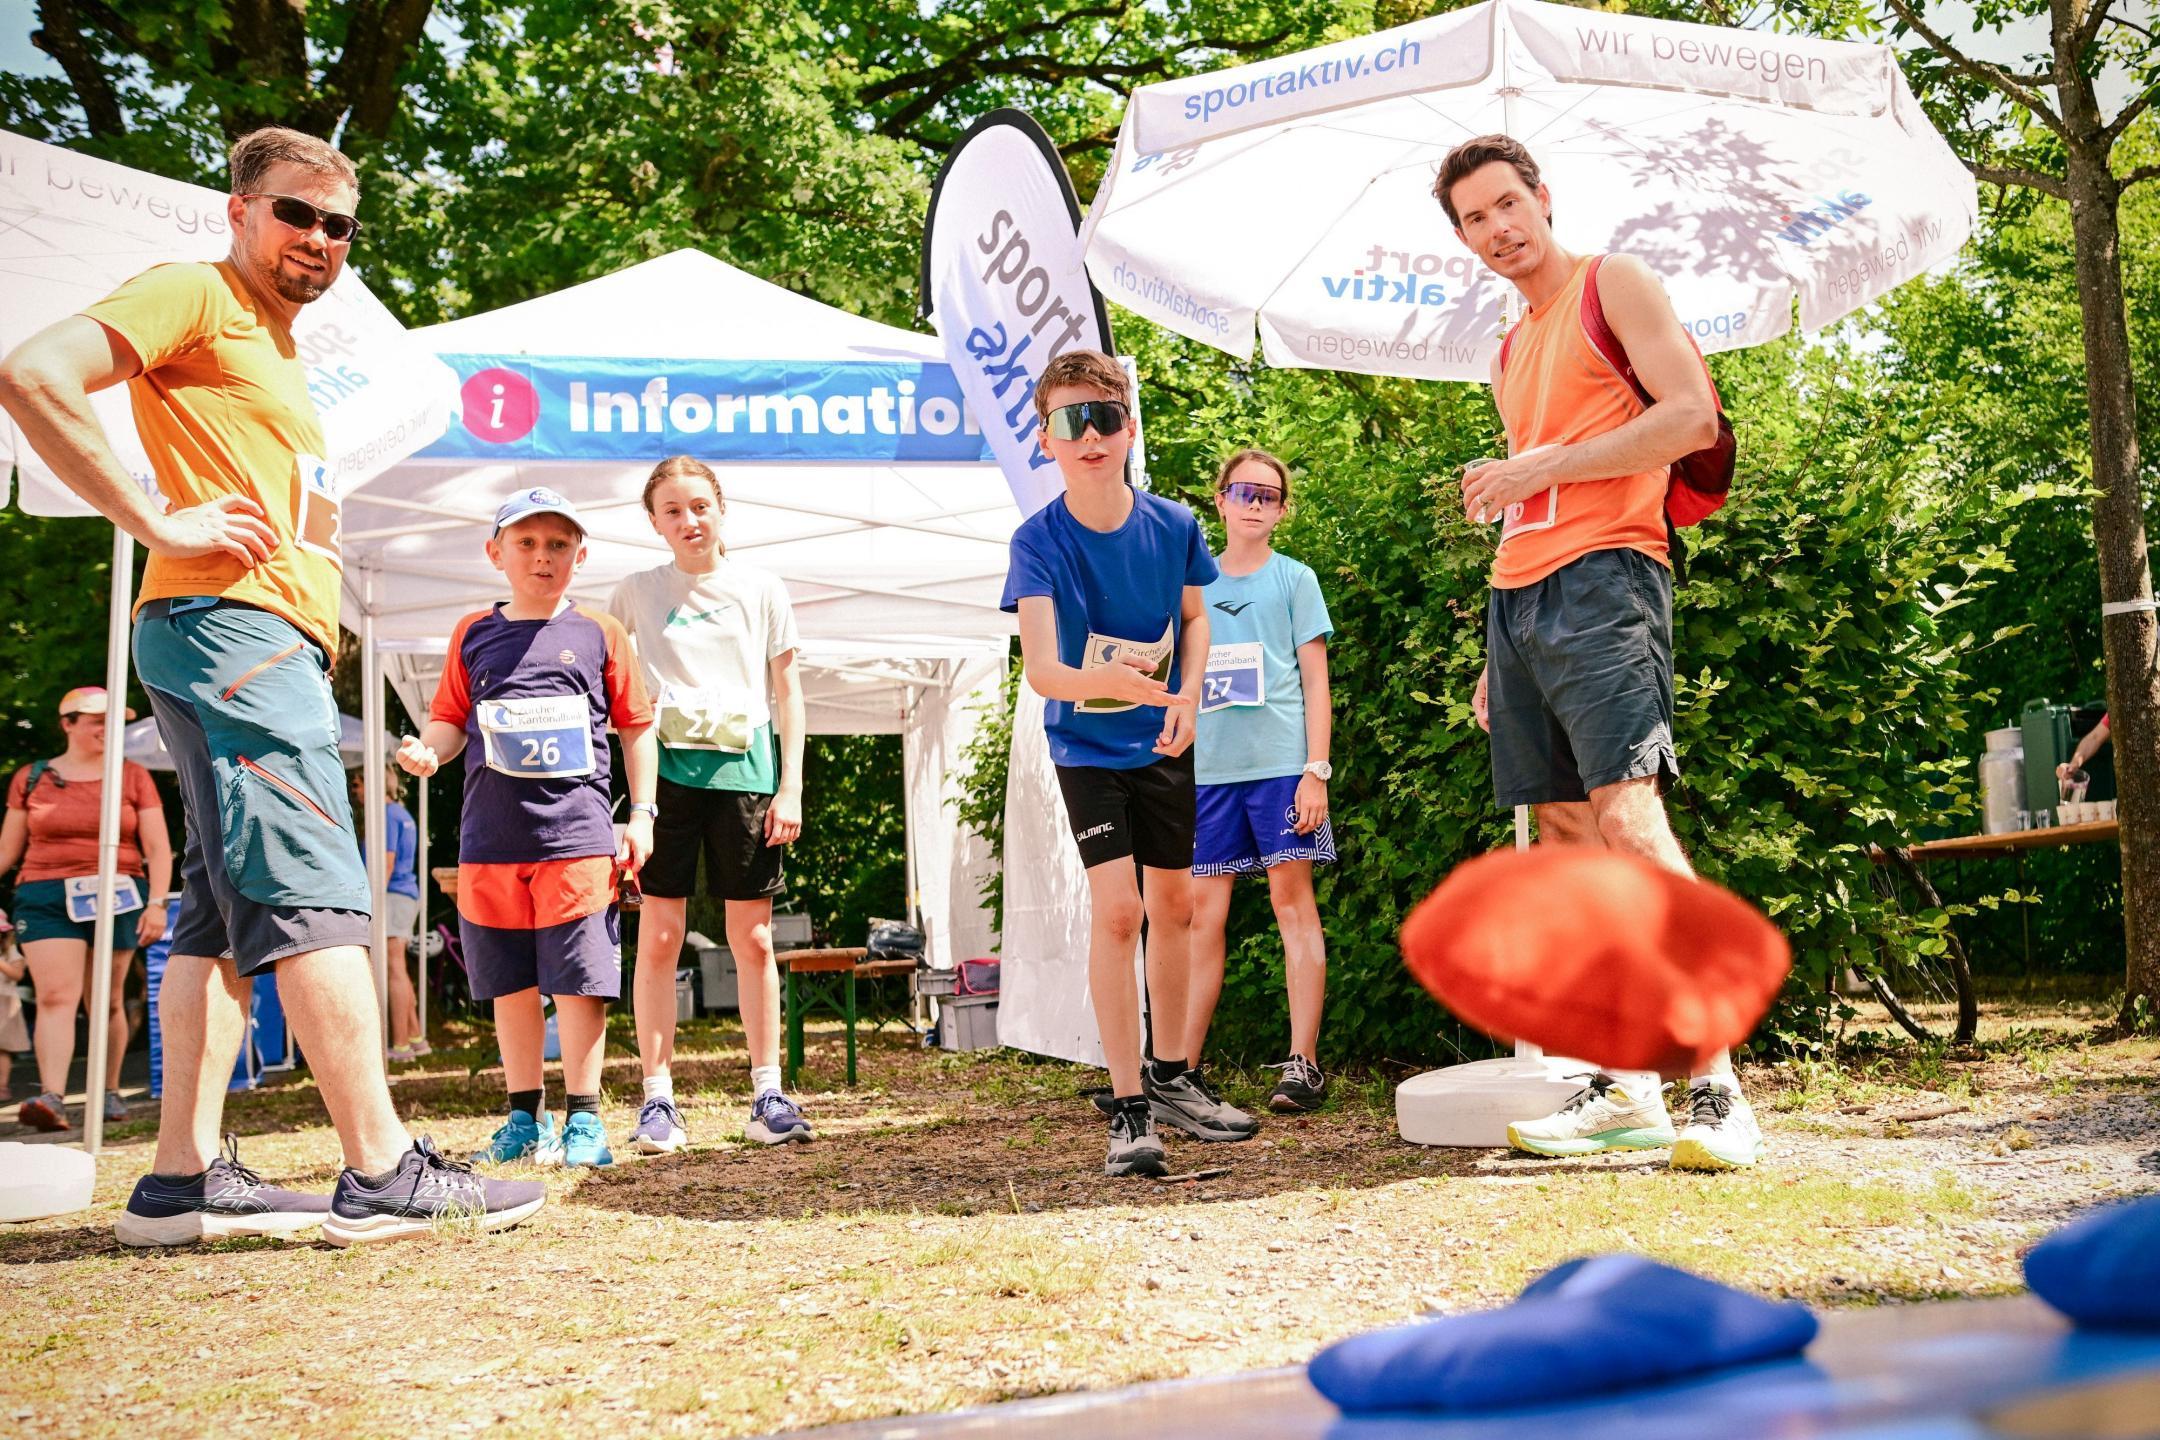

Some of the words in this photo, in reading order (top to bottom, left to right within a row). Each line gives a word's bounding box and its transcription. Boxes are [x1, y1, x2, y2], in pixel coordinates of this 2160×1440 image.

[1183, 37, 1422, 123] sportaktiv.ch
[1575, 26, 1635, 55] wir
[1651, 31, 1827, 84] bewegen
[46, 157, 227, 236] bewege
[977, 209, 1087, 363] sport
[1204, 676, 1233, 701] 27
[1206, 655, 1257, 667] antonalbank
[520, 736, 561, 766] 26
